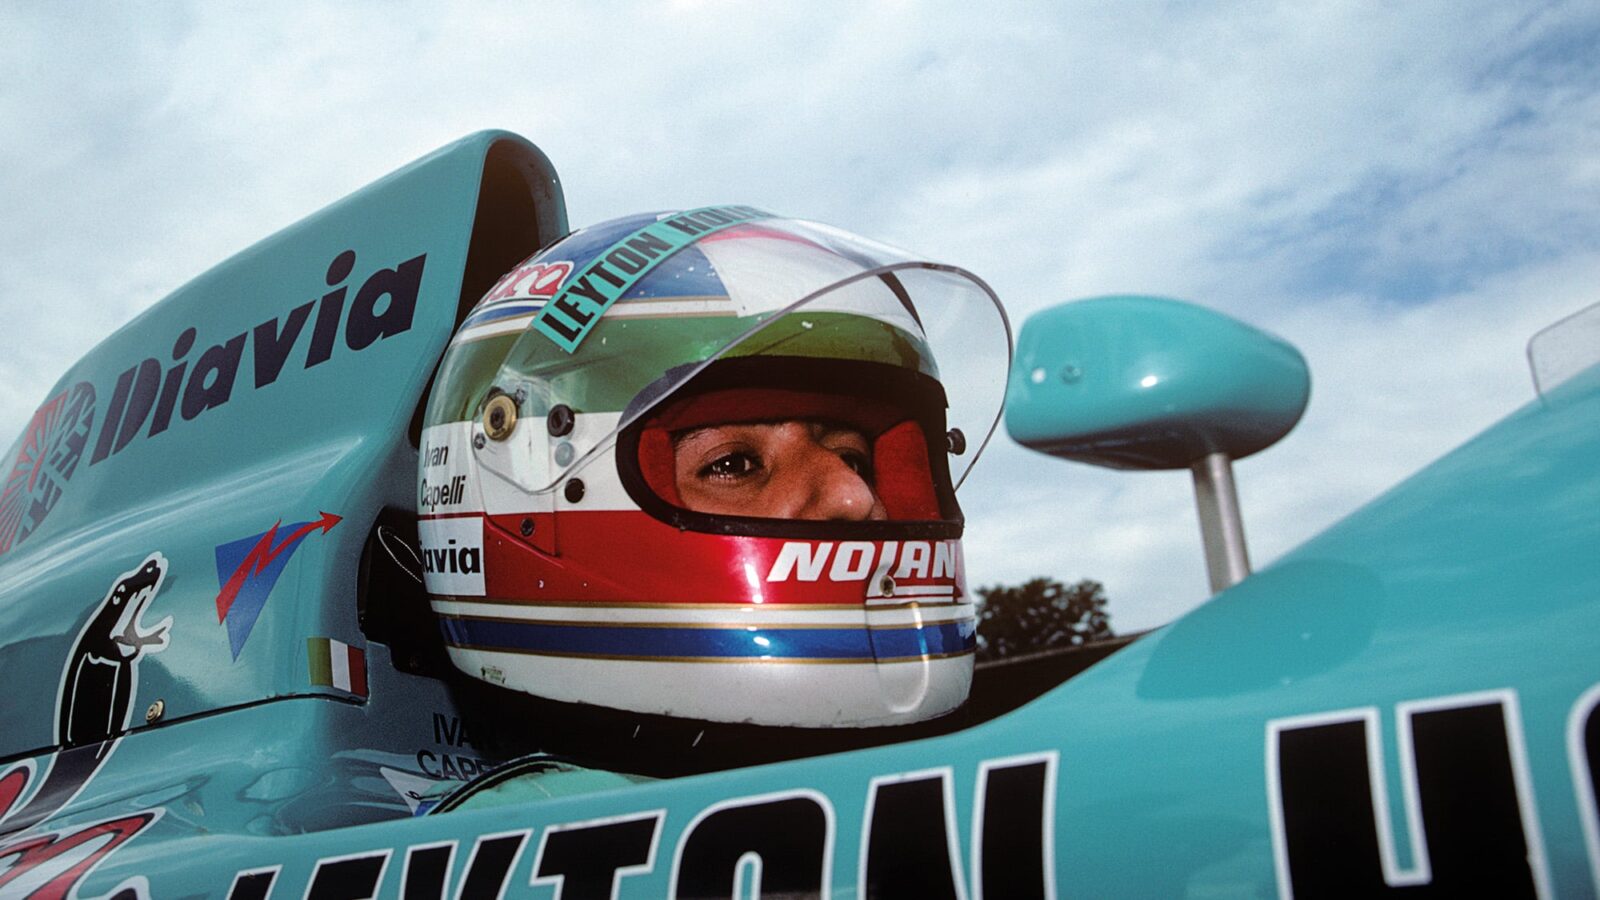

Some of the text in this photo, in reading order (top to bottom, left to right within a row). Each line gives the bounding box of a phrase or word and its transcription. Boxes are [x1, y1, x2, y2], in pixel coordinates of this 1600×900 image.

[541, 231, 673, 343] LEYTON
[90, 250, 427, 466] Diavia
[423, 441, 449, 467] Ivan
[420, 475, 466, 511] Capelli
[420, 539, 481, 575] avia
[416, 750, 496, 782] CAP
